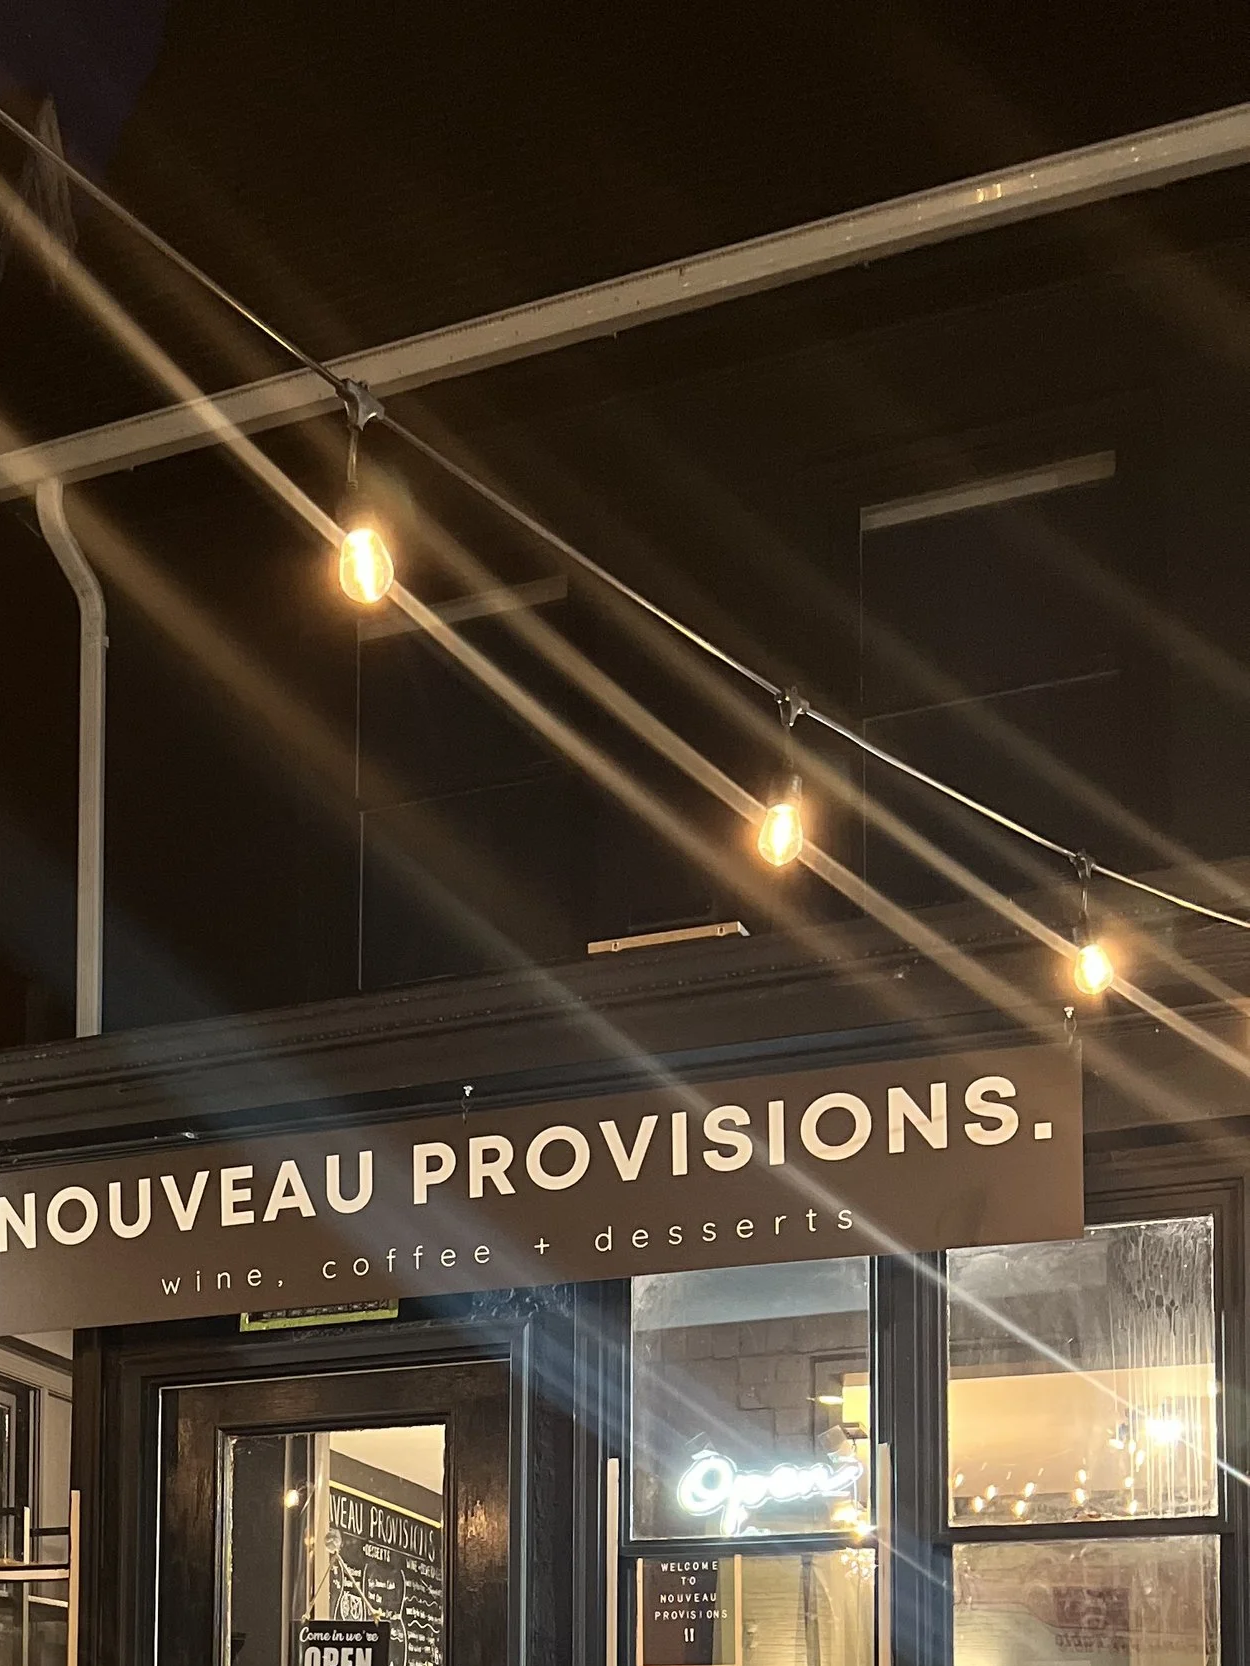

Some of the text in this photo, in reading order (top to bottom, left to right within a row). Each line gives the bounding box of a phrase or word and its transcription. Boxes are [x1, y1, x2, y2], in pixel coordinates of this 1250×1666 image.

[413, 1075, 1053, 1205] PROVISIONS.
[161, 1263, 285, 1296] wine,
[321, 1241, 491, 1280] coffee
[594, 1206, 854, 1253] desserts
[678, 1454, 864, 1537] Open
[660, 1560, 719, 1572] WELCOME
[681, 1576, 697, 1586] TO
[659, 1592, 718, 1604] NOUVEAU
[654, 1609, 729, 1621] PROVISIONS
[299, 1626, 331, 1642] Come
[332, 1629, 344, 1642] in
[345, 1629, 379, 1642] we're
